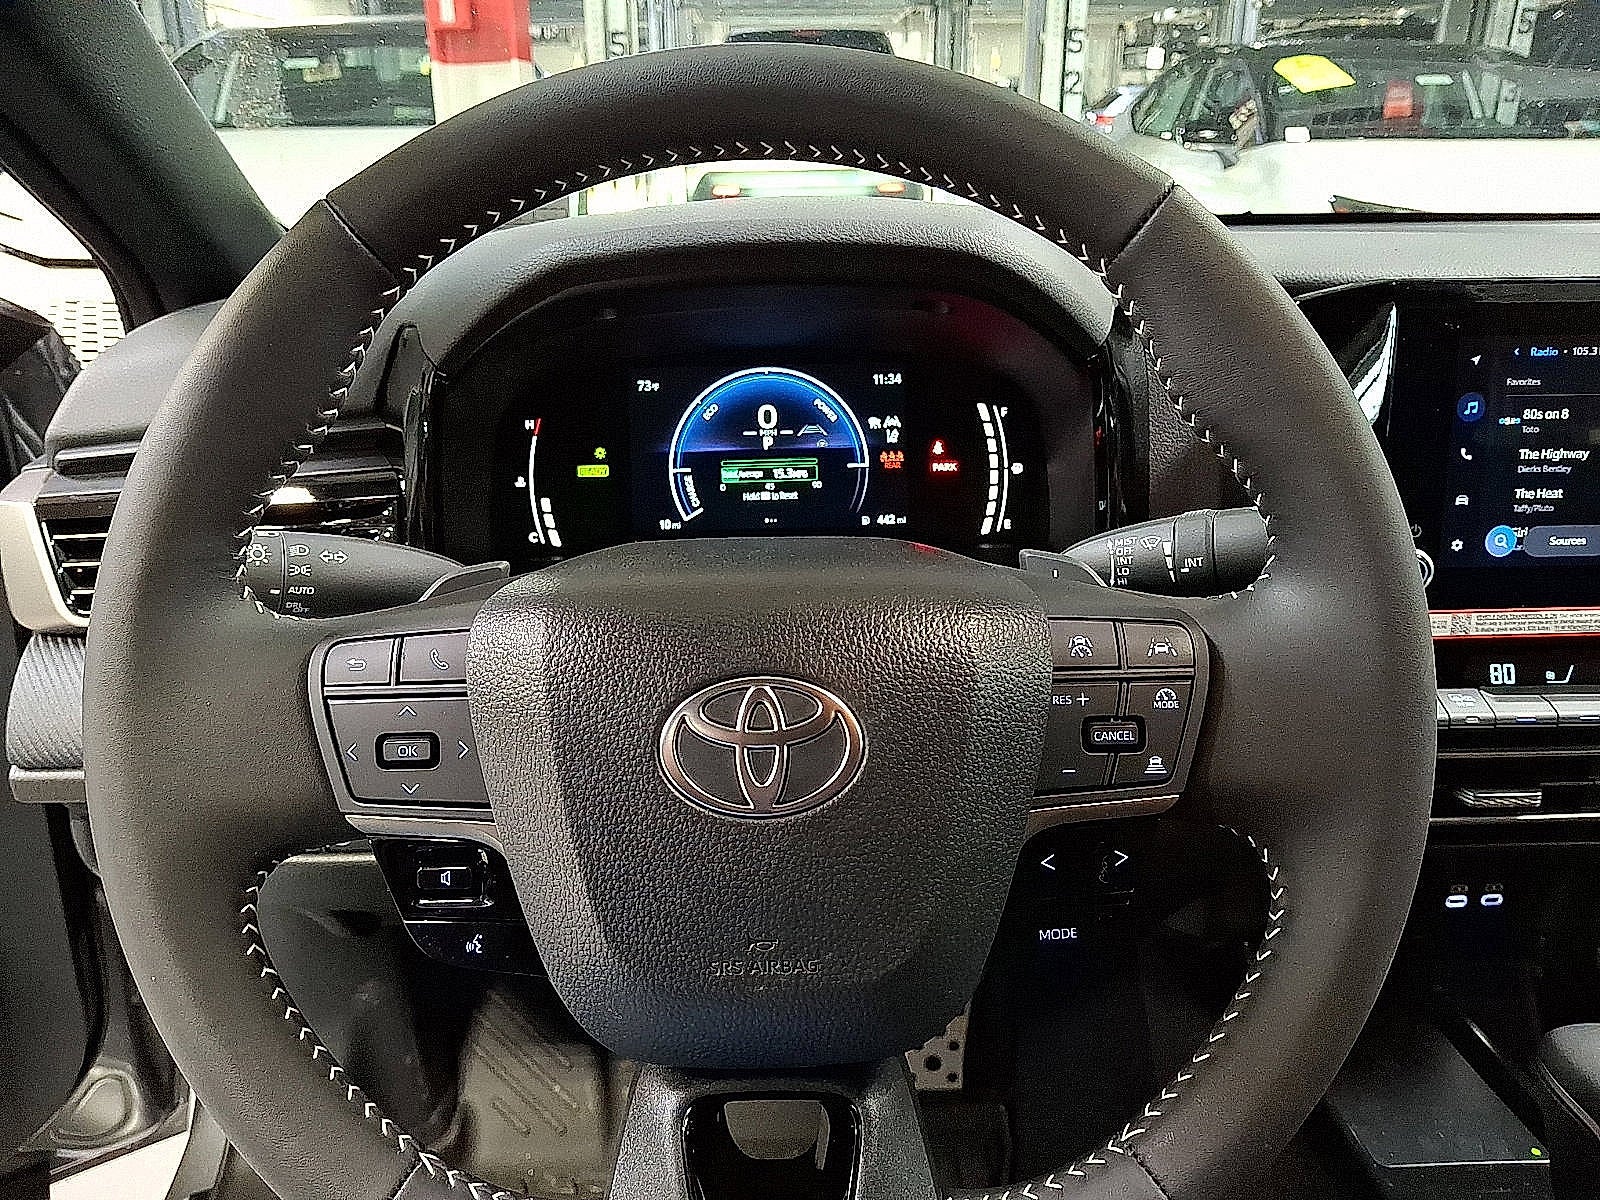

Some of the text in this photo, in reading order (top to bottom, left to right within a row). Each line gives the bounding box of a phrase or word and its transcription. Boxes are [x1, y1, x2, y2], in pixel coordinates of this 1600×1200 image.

[1067, 28, 1083, 53] 5
[1530, 346, 1598, 357] Radio 105.3
[873, 373, 902, 385] 11:34
[1506, 377, 1542, 386] Favorites
[701, 402, 719, 421] ECO
[757, 404, 778, 429] 0
[813, 398, 838, 423] POWER
[1522, 407, 1570, 420] 80s on 8
[524, 419, 535, 431] H
[1521, 425, 1540, 434] Toto
[762, 436, 774, 451] P
[1518, 447, 1590, 462] The Highway
[931, 461, 958, 473] PARK
[1517, 464, 1573, 475] Dierks Bentley
[1513, 487, 1564, 500] The Heat
[659, 518, 672, 531] 10
[1548, 535, 1588, 547] Sources
[1115, 547, 1134, 556] OFF
[1116, 556, 1134, 566] INT
[1184, 556, 1204, 568] INT
[1116, 567, 1131, 576] LO
[1117, 578, 1128, 586] HI
[287, 586, 316, 596] AUTO
[1489, 663, 1516, 685] 80
[1052, 695, 1073, 706] RES
[1153, 700, 1180, 709] MODE
[1093, 731, 1136, 741] CANCEL
[397, 744, 418, 758] OK
[1038, 927, 1078, 941] MODE
[708, 959, 820, 976] SRS AIRBAG
